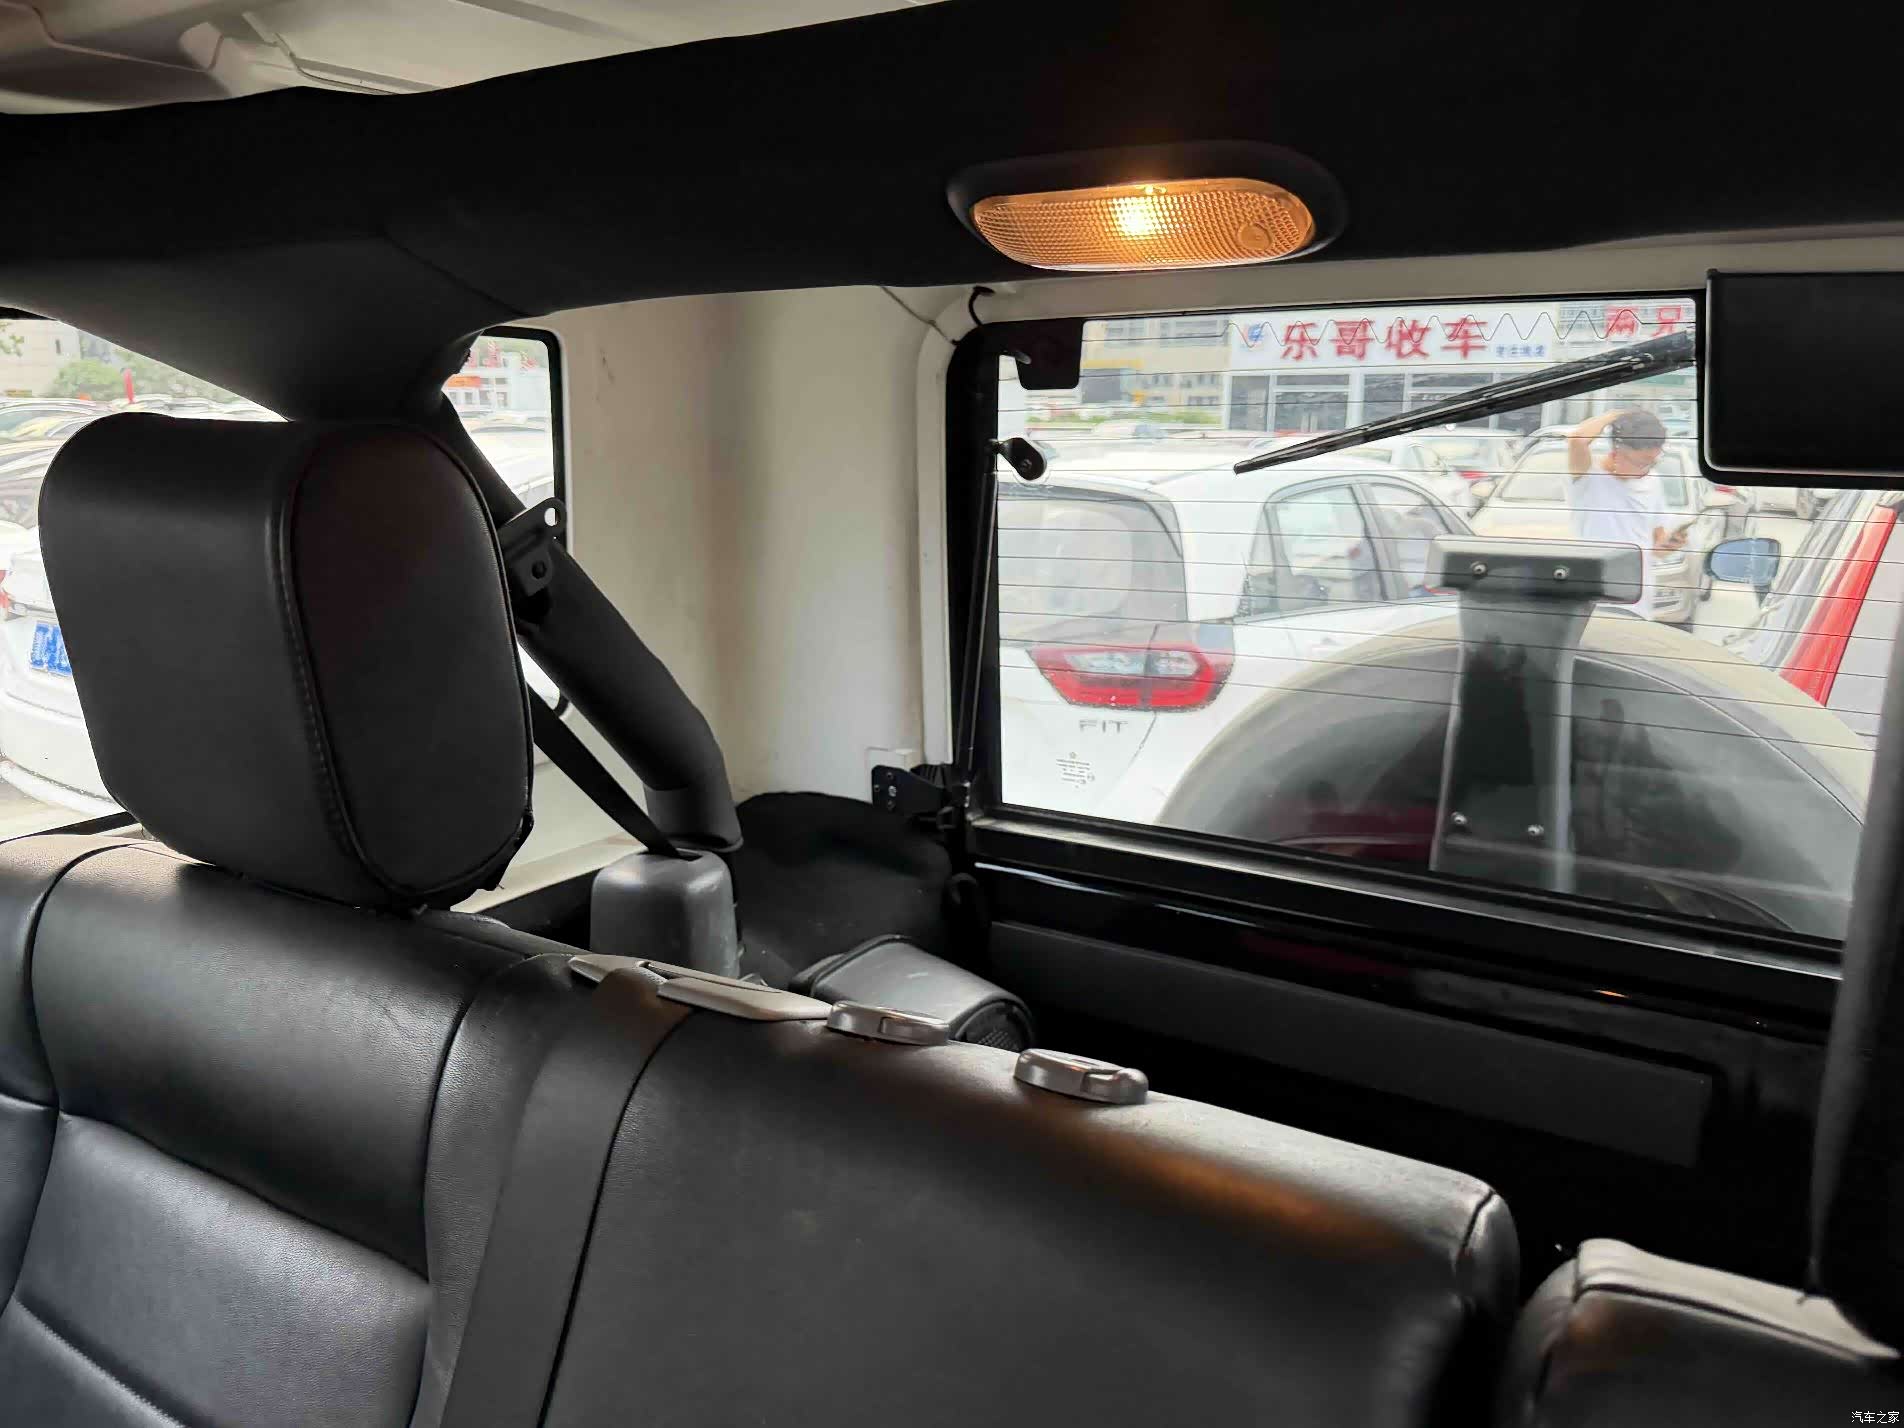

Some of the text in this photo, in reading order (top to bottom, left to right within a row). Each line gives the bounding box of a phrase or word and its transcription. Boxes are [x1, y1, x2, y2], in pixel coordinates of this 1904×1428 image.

[1281, 318, 1488, 361] 乐哥收车
[1079, 719, 1128, 734] FIT
